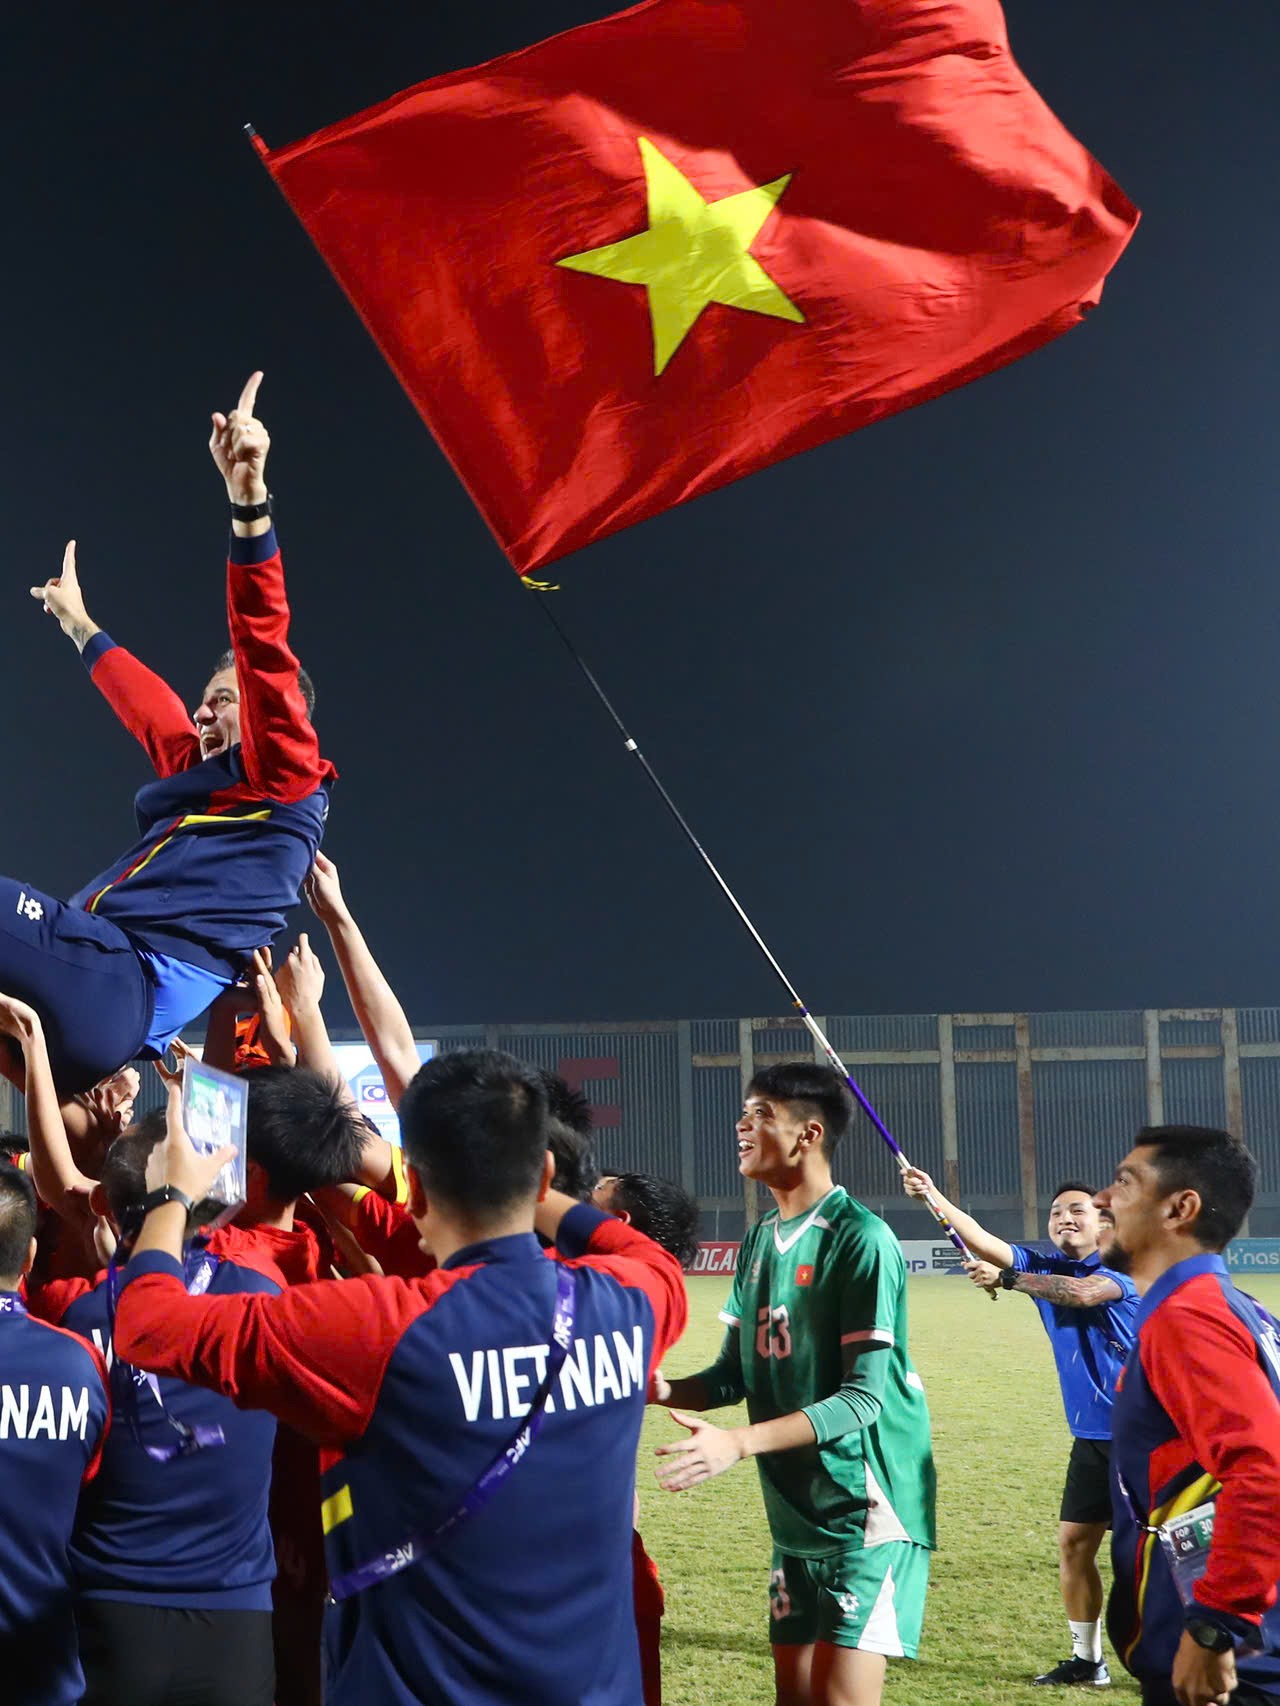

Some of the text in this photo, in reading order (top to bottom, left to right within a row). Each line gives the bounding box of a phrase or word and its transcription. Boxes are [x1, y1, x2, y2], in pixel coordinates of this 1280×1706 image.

[1226, 1248, 1280, 1265] k'nas
[553, 1313, 573, 1350] AFC
[448, 1325, 644, 1422] VIETNAM
[506, 1426, 531, 1464] AFC
[385, 1542, 414, 1571] AFC
